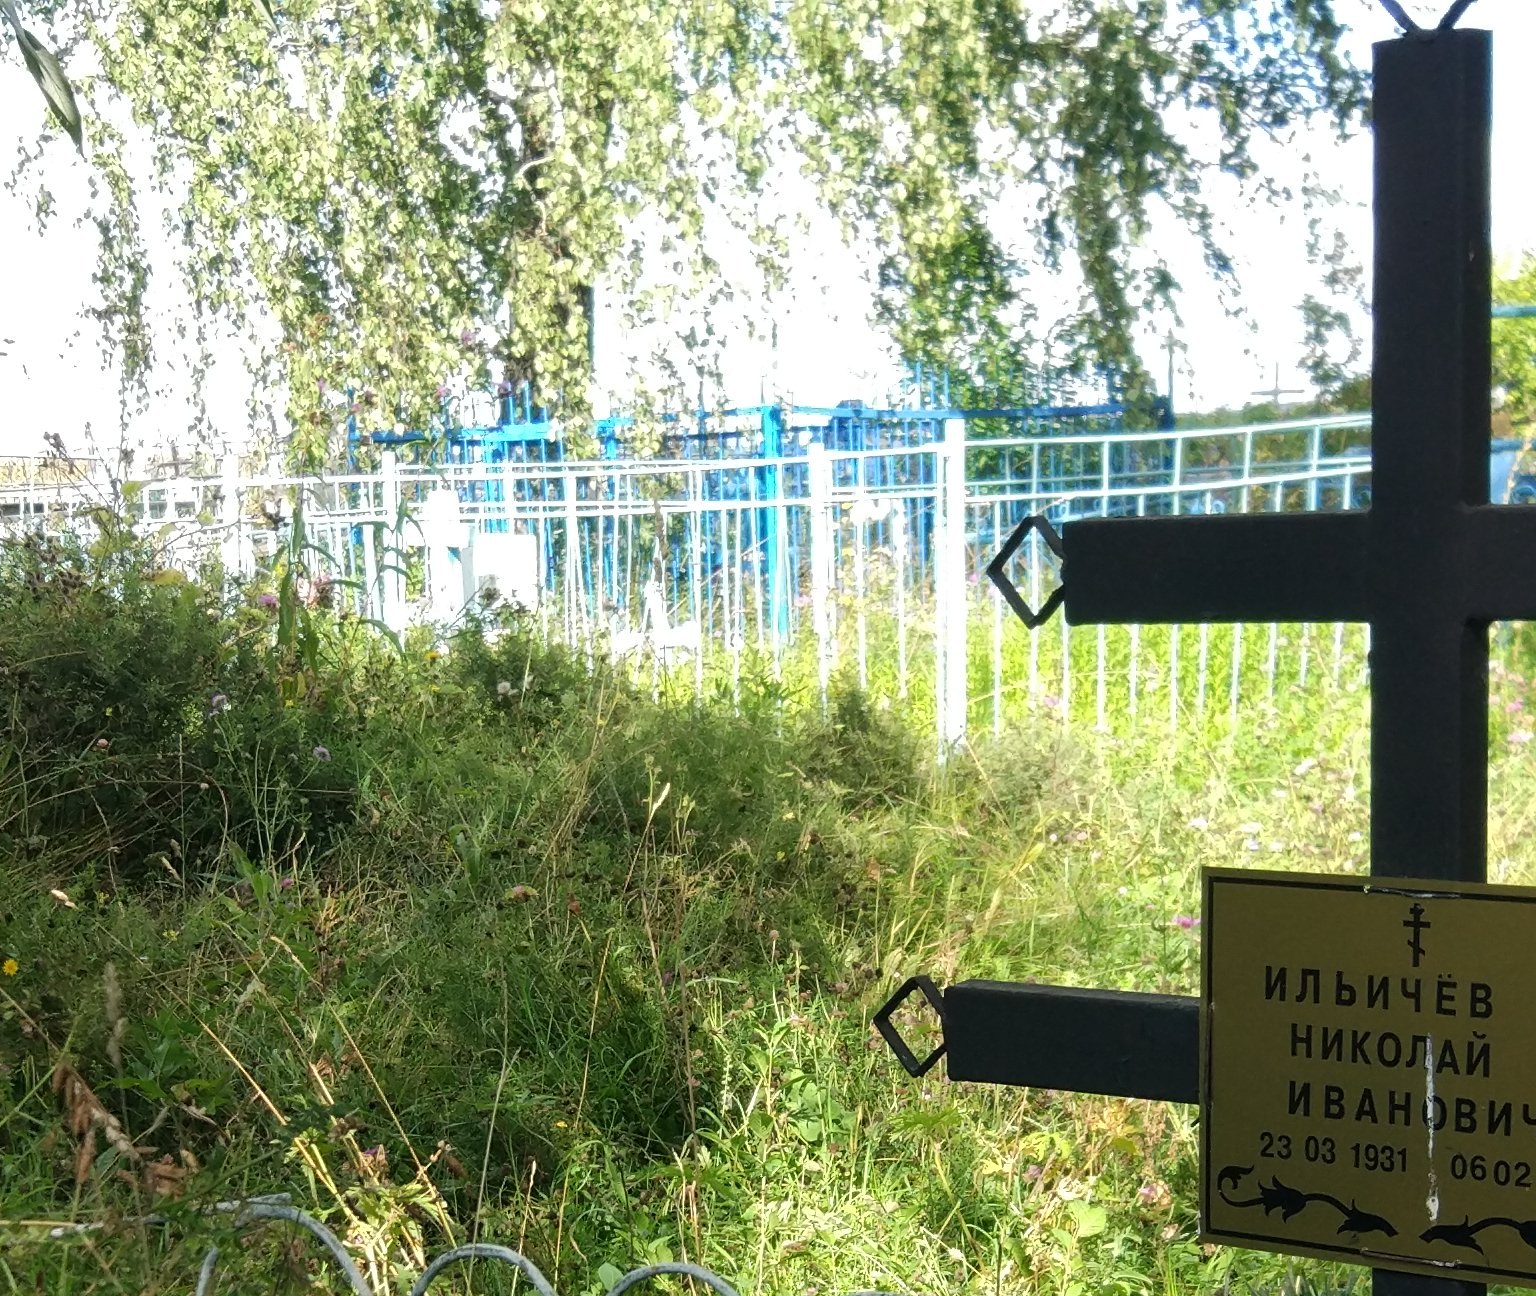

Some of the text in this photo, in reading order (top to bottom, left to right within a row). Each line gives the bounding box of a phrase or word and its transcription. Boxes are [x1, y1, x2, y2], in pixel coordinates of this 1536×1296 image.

[1264, 965, 1493, 1019] ИЛЬИЧЁВ
[1290, 1023, 1492, 1079] НИКОЛАЙ
[1260, 1131, 1292, 1160] 23
[1304, 1135, 1336, 1165] 03
[1350, 1142, 1407, 1173] 1931
